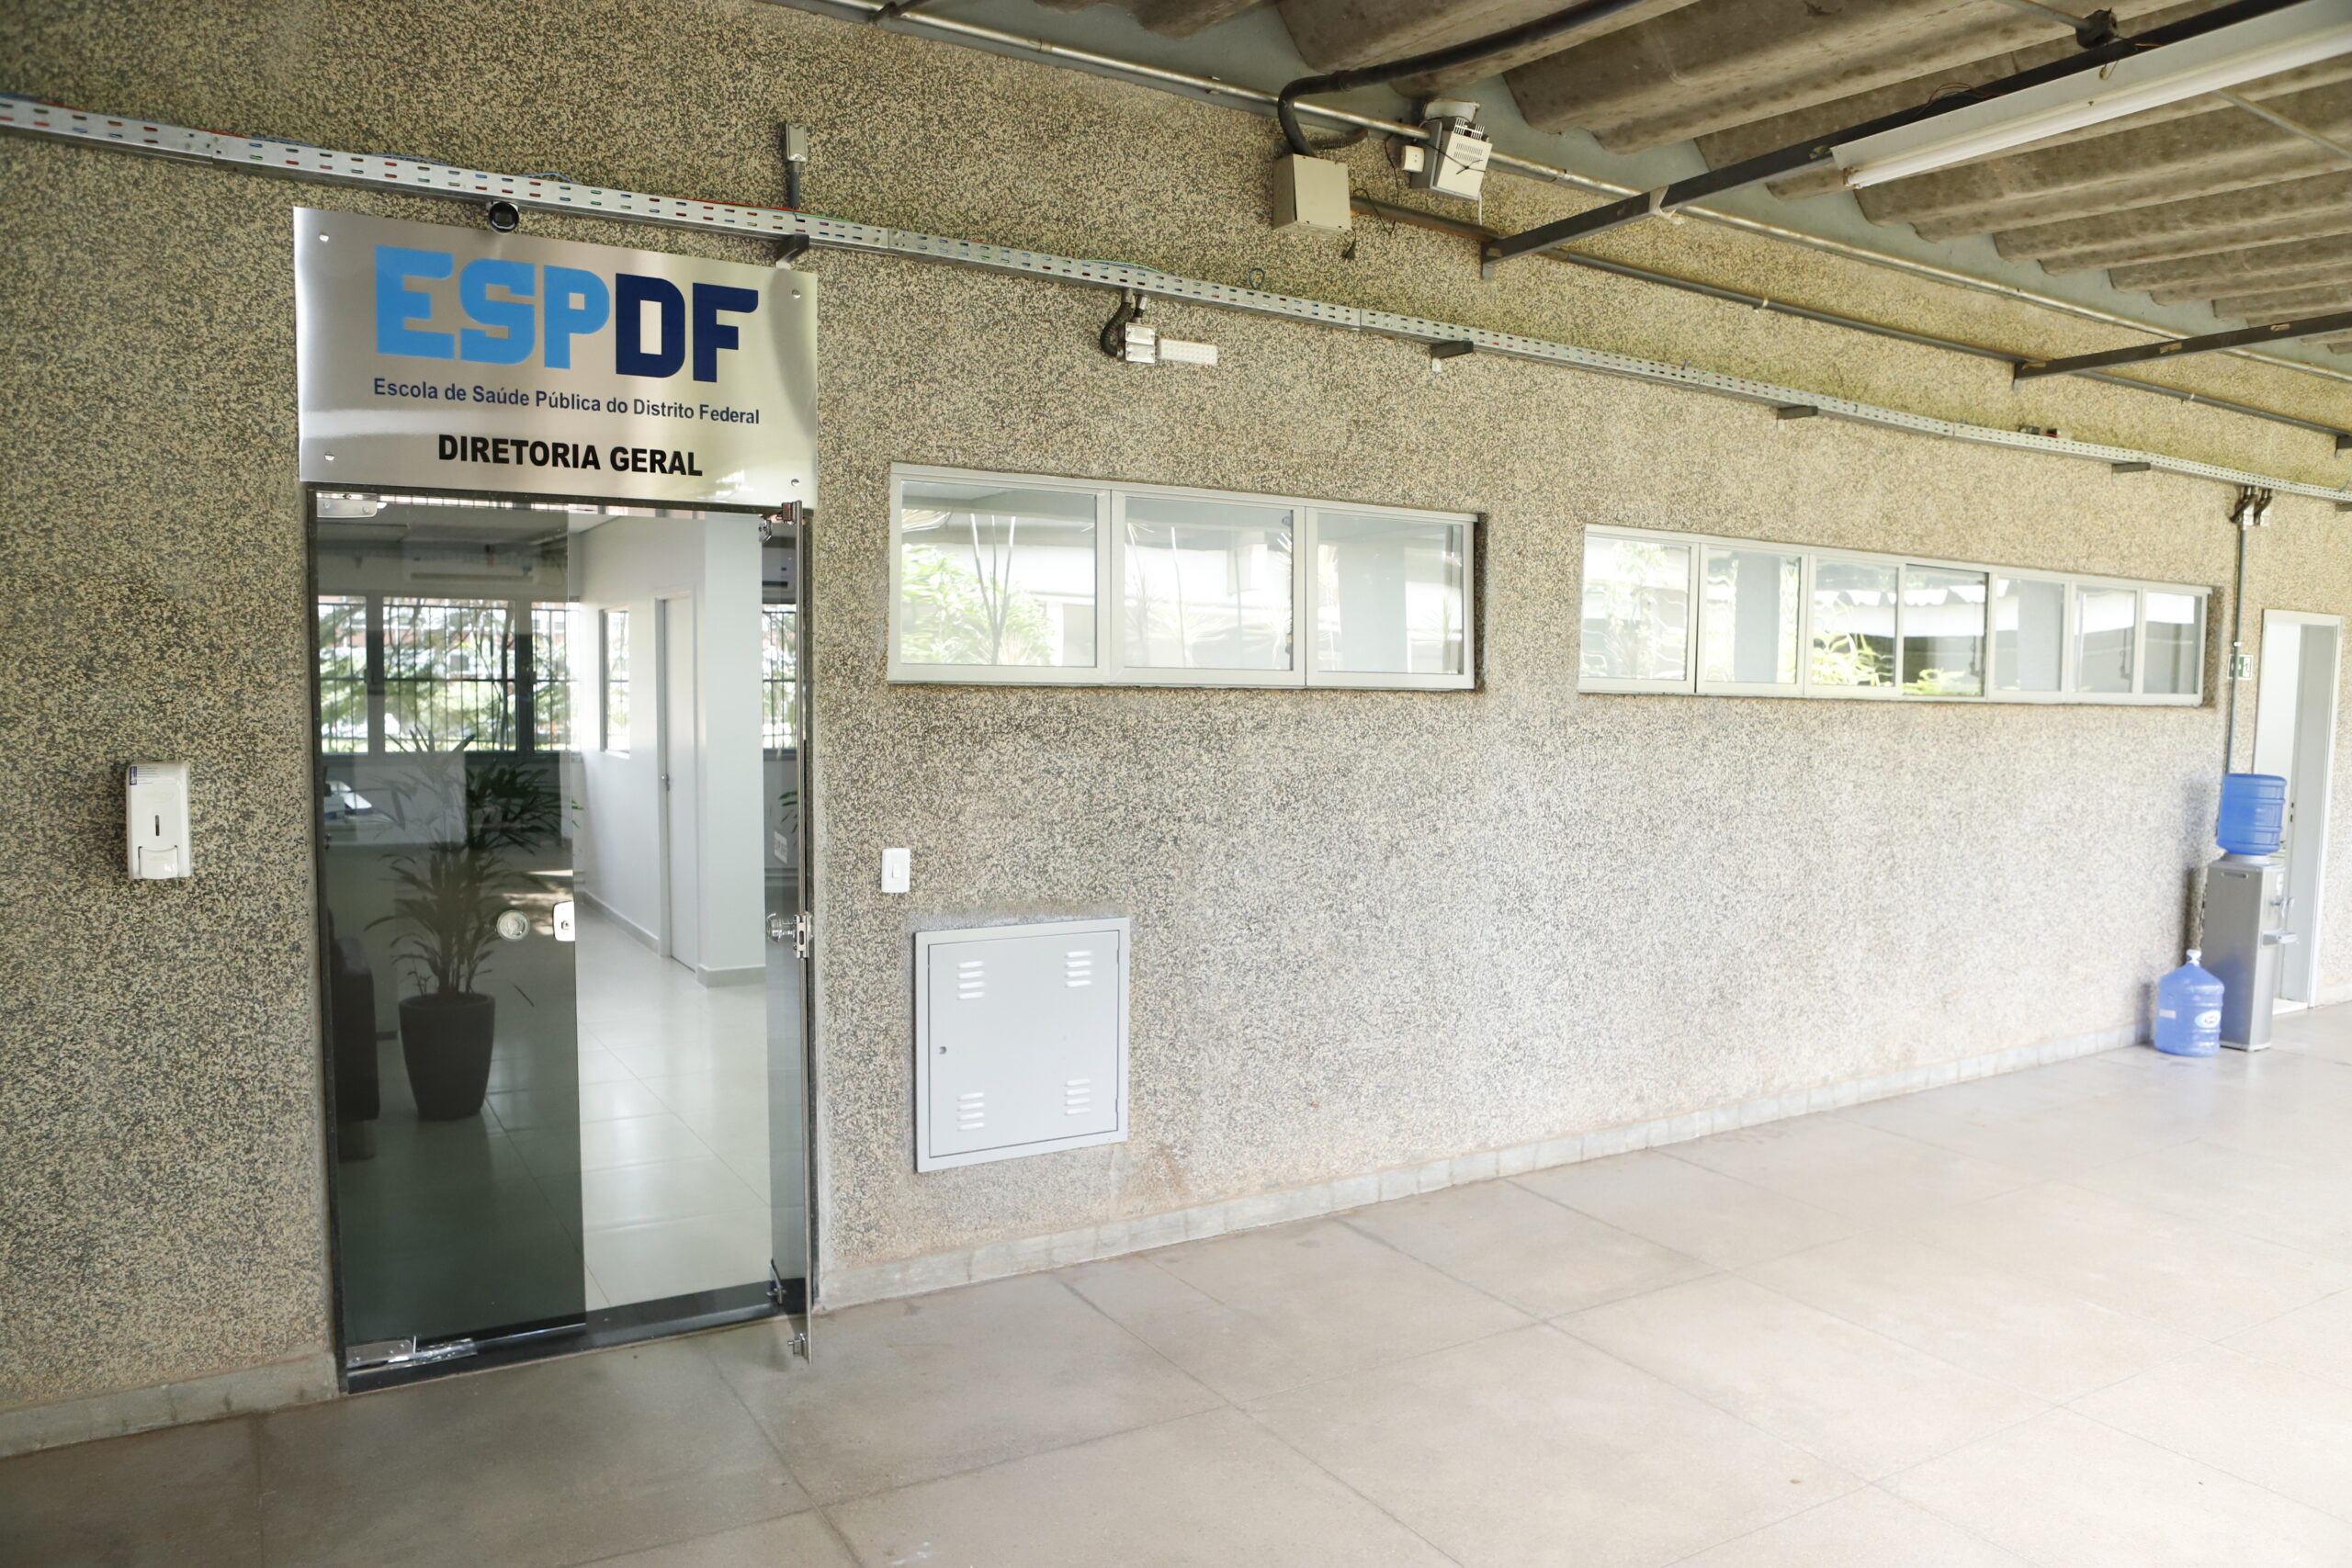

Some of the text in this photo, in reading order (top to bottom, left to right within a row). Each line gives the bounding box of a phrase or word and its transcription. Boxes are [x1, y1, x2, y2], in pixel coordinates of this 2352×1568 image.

[374, 244, 759, 383] ESPDF
[373, 377, 760, 424] Escola de Saúde Pública do Distrito Federal
[438, 434, 703, 477] DIRETORIA GERAL
